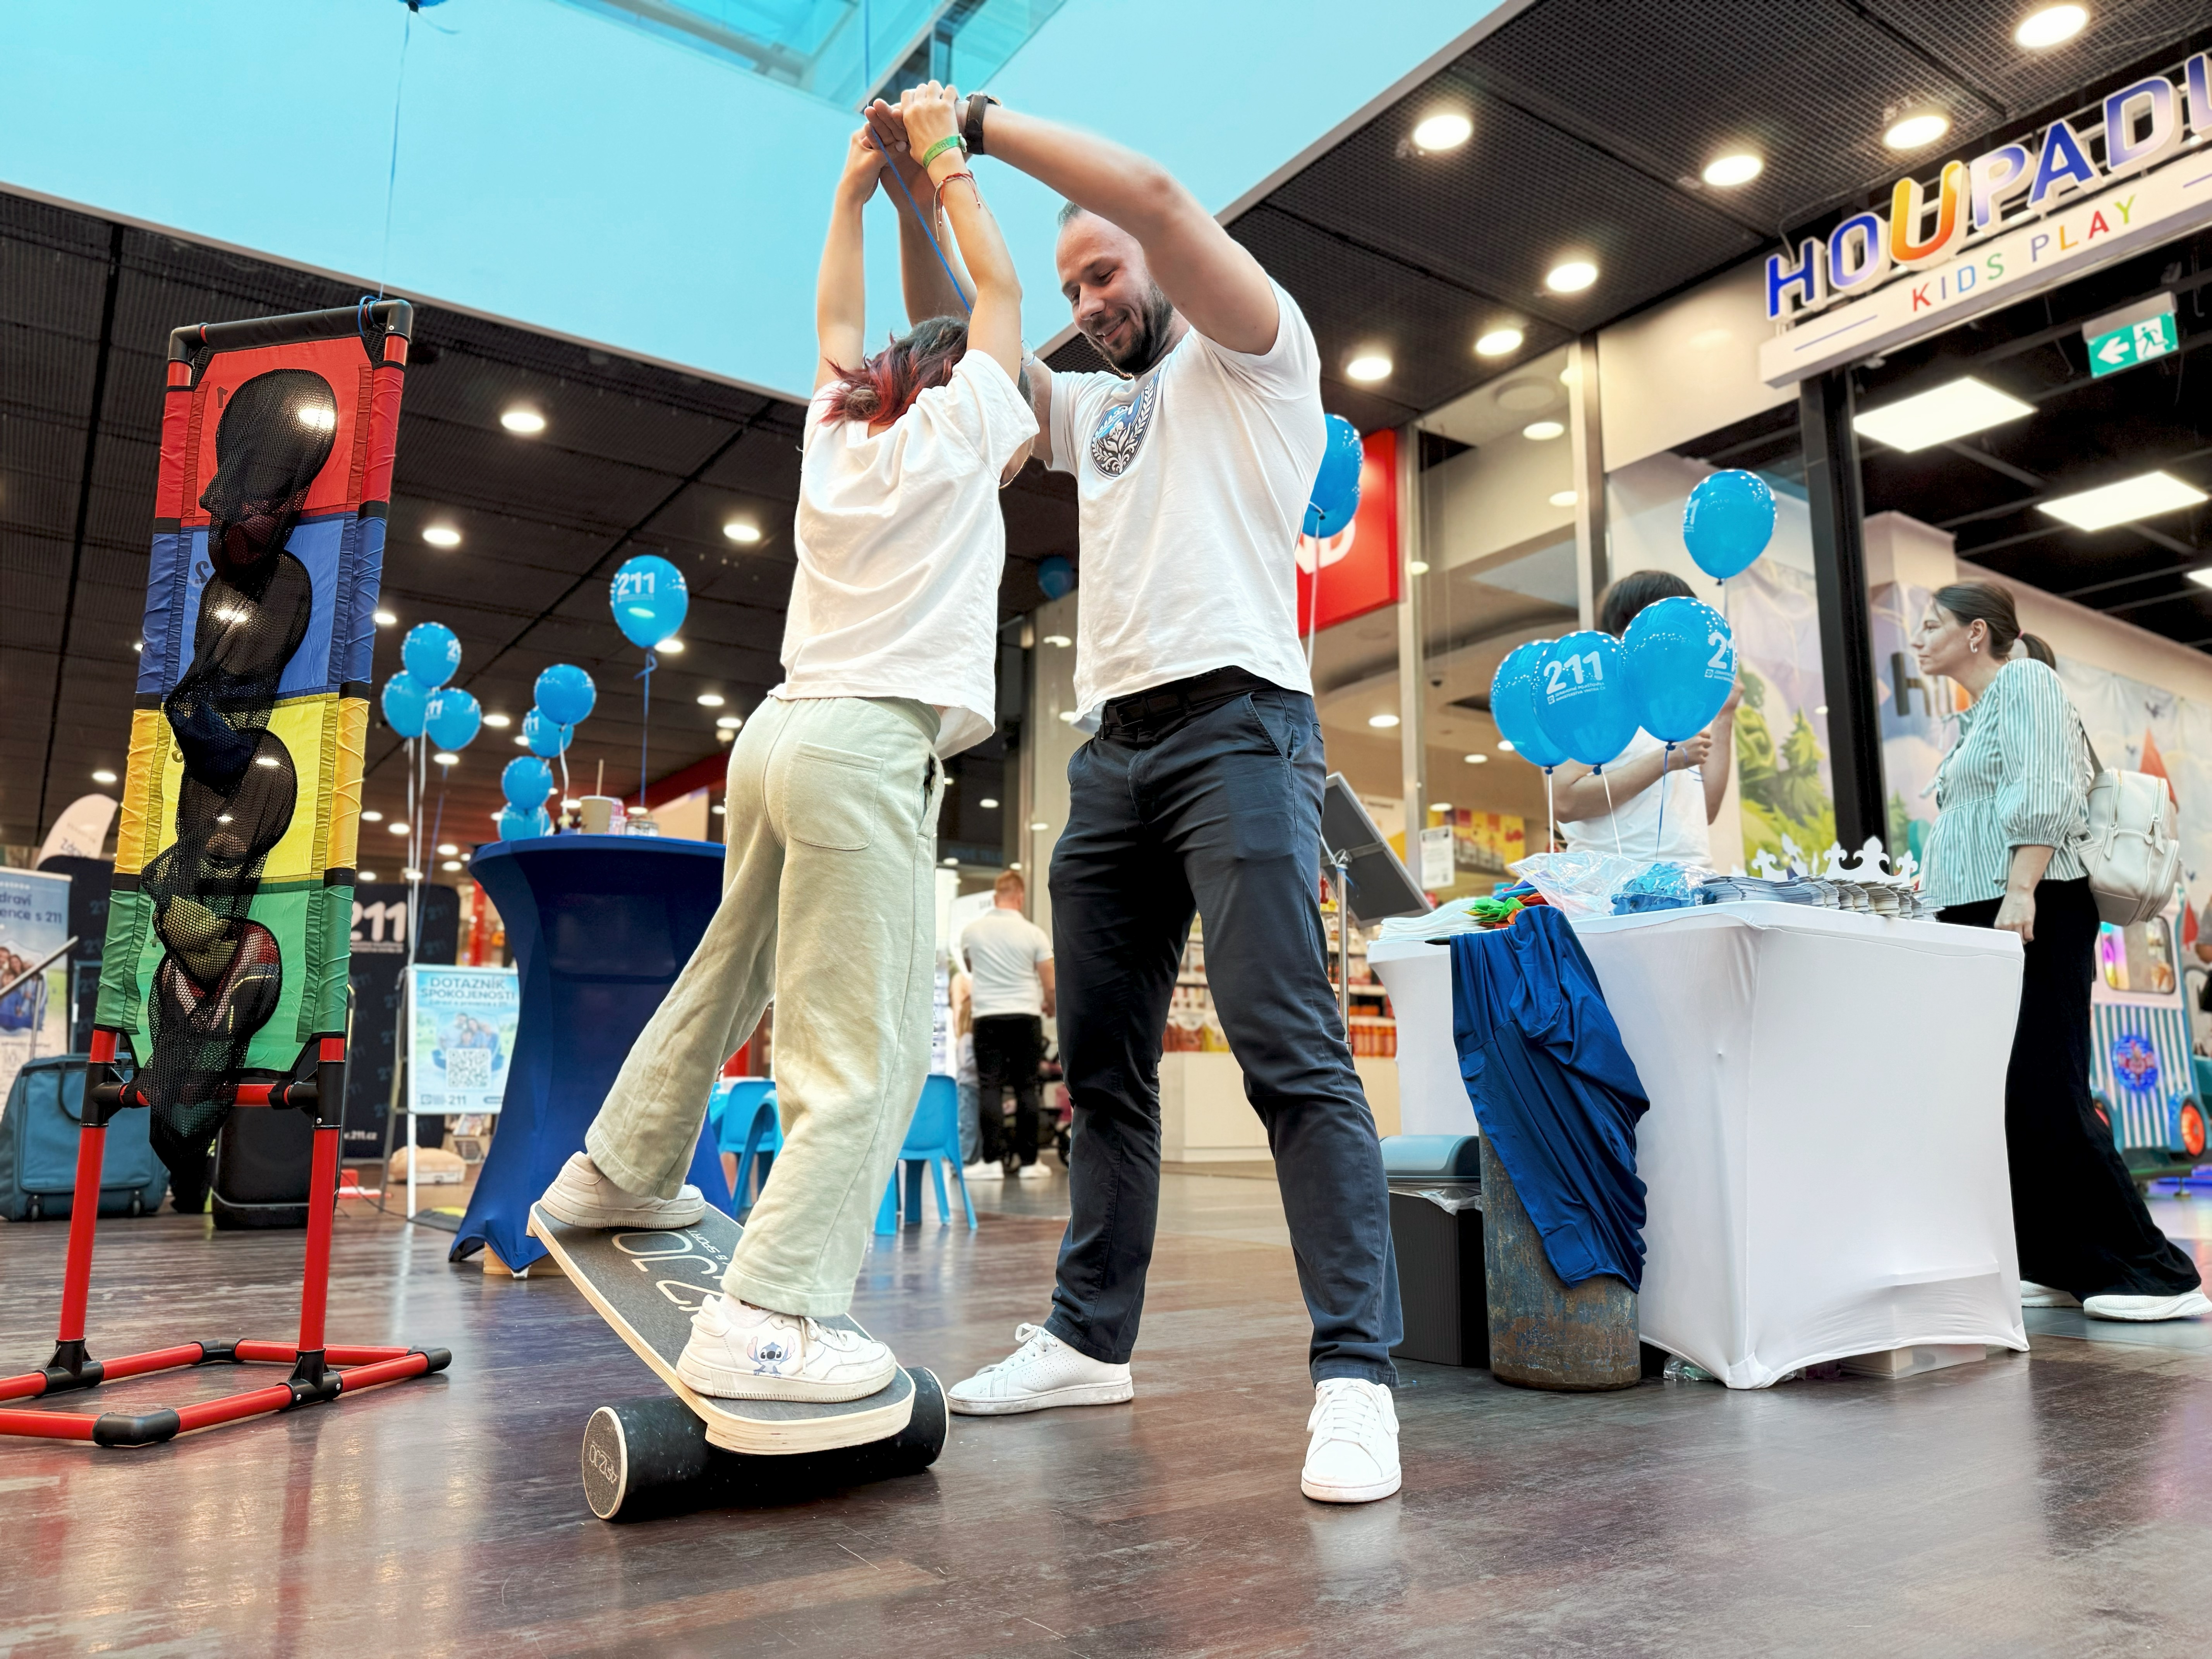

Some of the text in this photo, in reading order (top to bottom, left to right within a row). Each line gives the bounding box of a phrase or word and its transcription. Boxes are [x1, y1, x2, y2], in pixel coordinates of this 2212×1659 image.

[1912, 194, 2136, 312] KIDS PLAY
[617, 571, 655, 595] 211
[1543, 651, 1603, 695] 211
[45, 911, 62, 924] 211
[430, 974, 505, 989] DOTAZNÍK
[421, 988, 515, 1000] SPOKOJENOSTI
[449, 1095, 466, 1105] 211
[685, 1229, 721, 1253] SPORT
